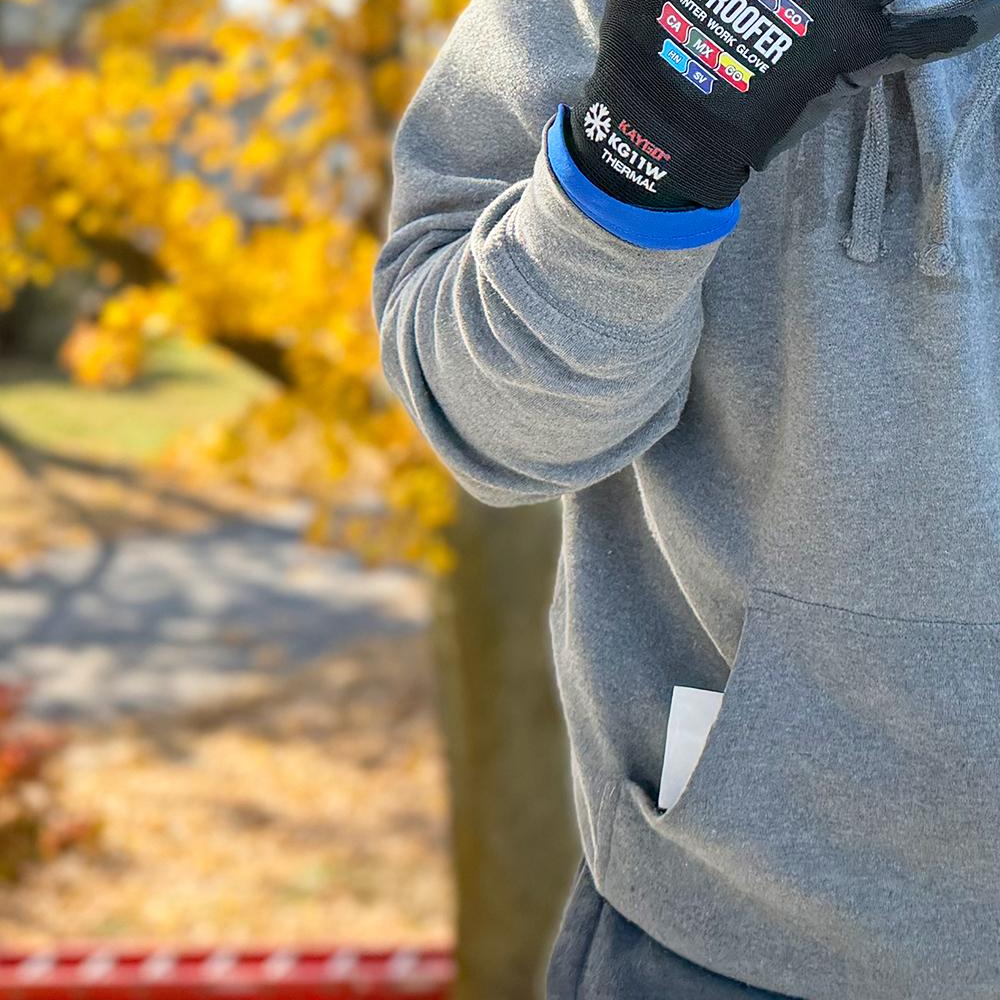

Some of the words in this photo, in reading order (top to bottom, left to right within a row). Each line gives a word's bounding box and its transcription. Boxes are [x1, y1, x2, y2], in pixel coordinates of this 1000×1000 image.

[666, 15, 681, 32] CA
[693, 39, 713, 58] MX
[784, 8, 801, 25] CO
[707, 18, 737, 47] WORK
[736, 44, 770, 74] GLOVE
[693, 72, 707, 83] SV
[601, 148, 657, 193] THERMAL
[608, 132, 667, 180] KG11W
